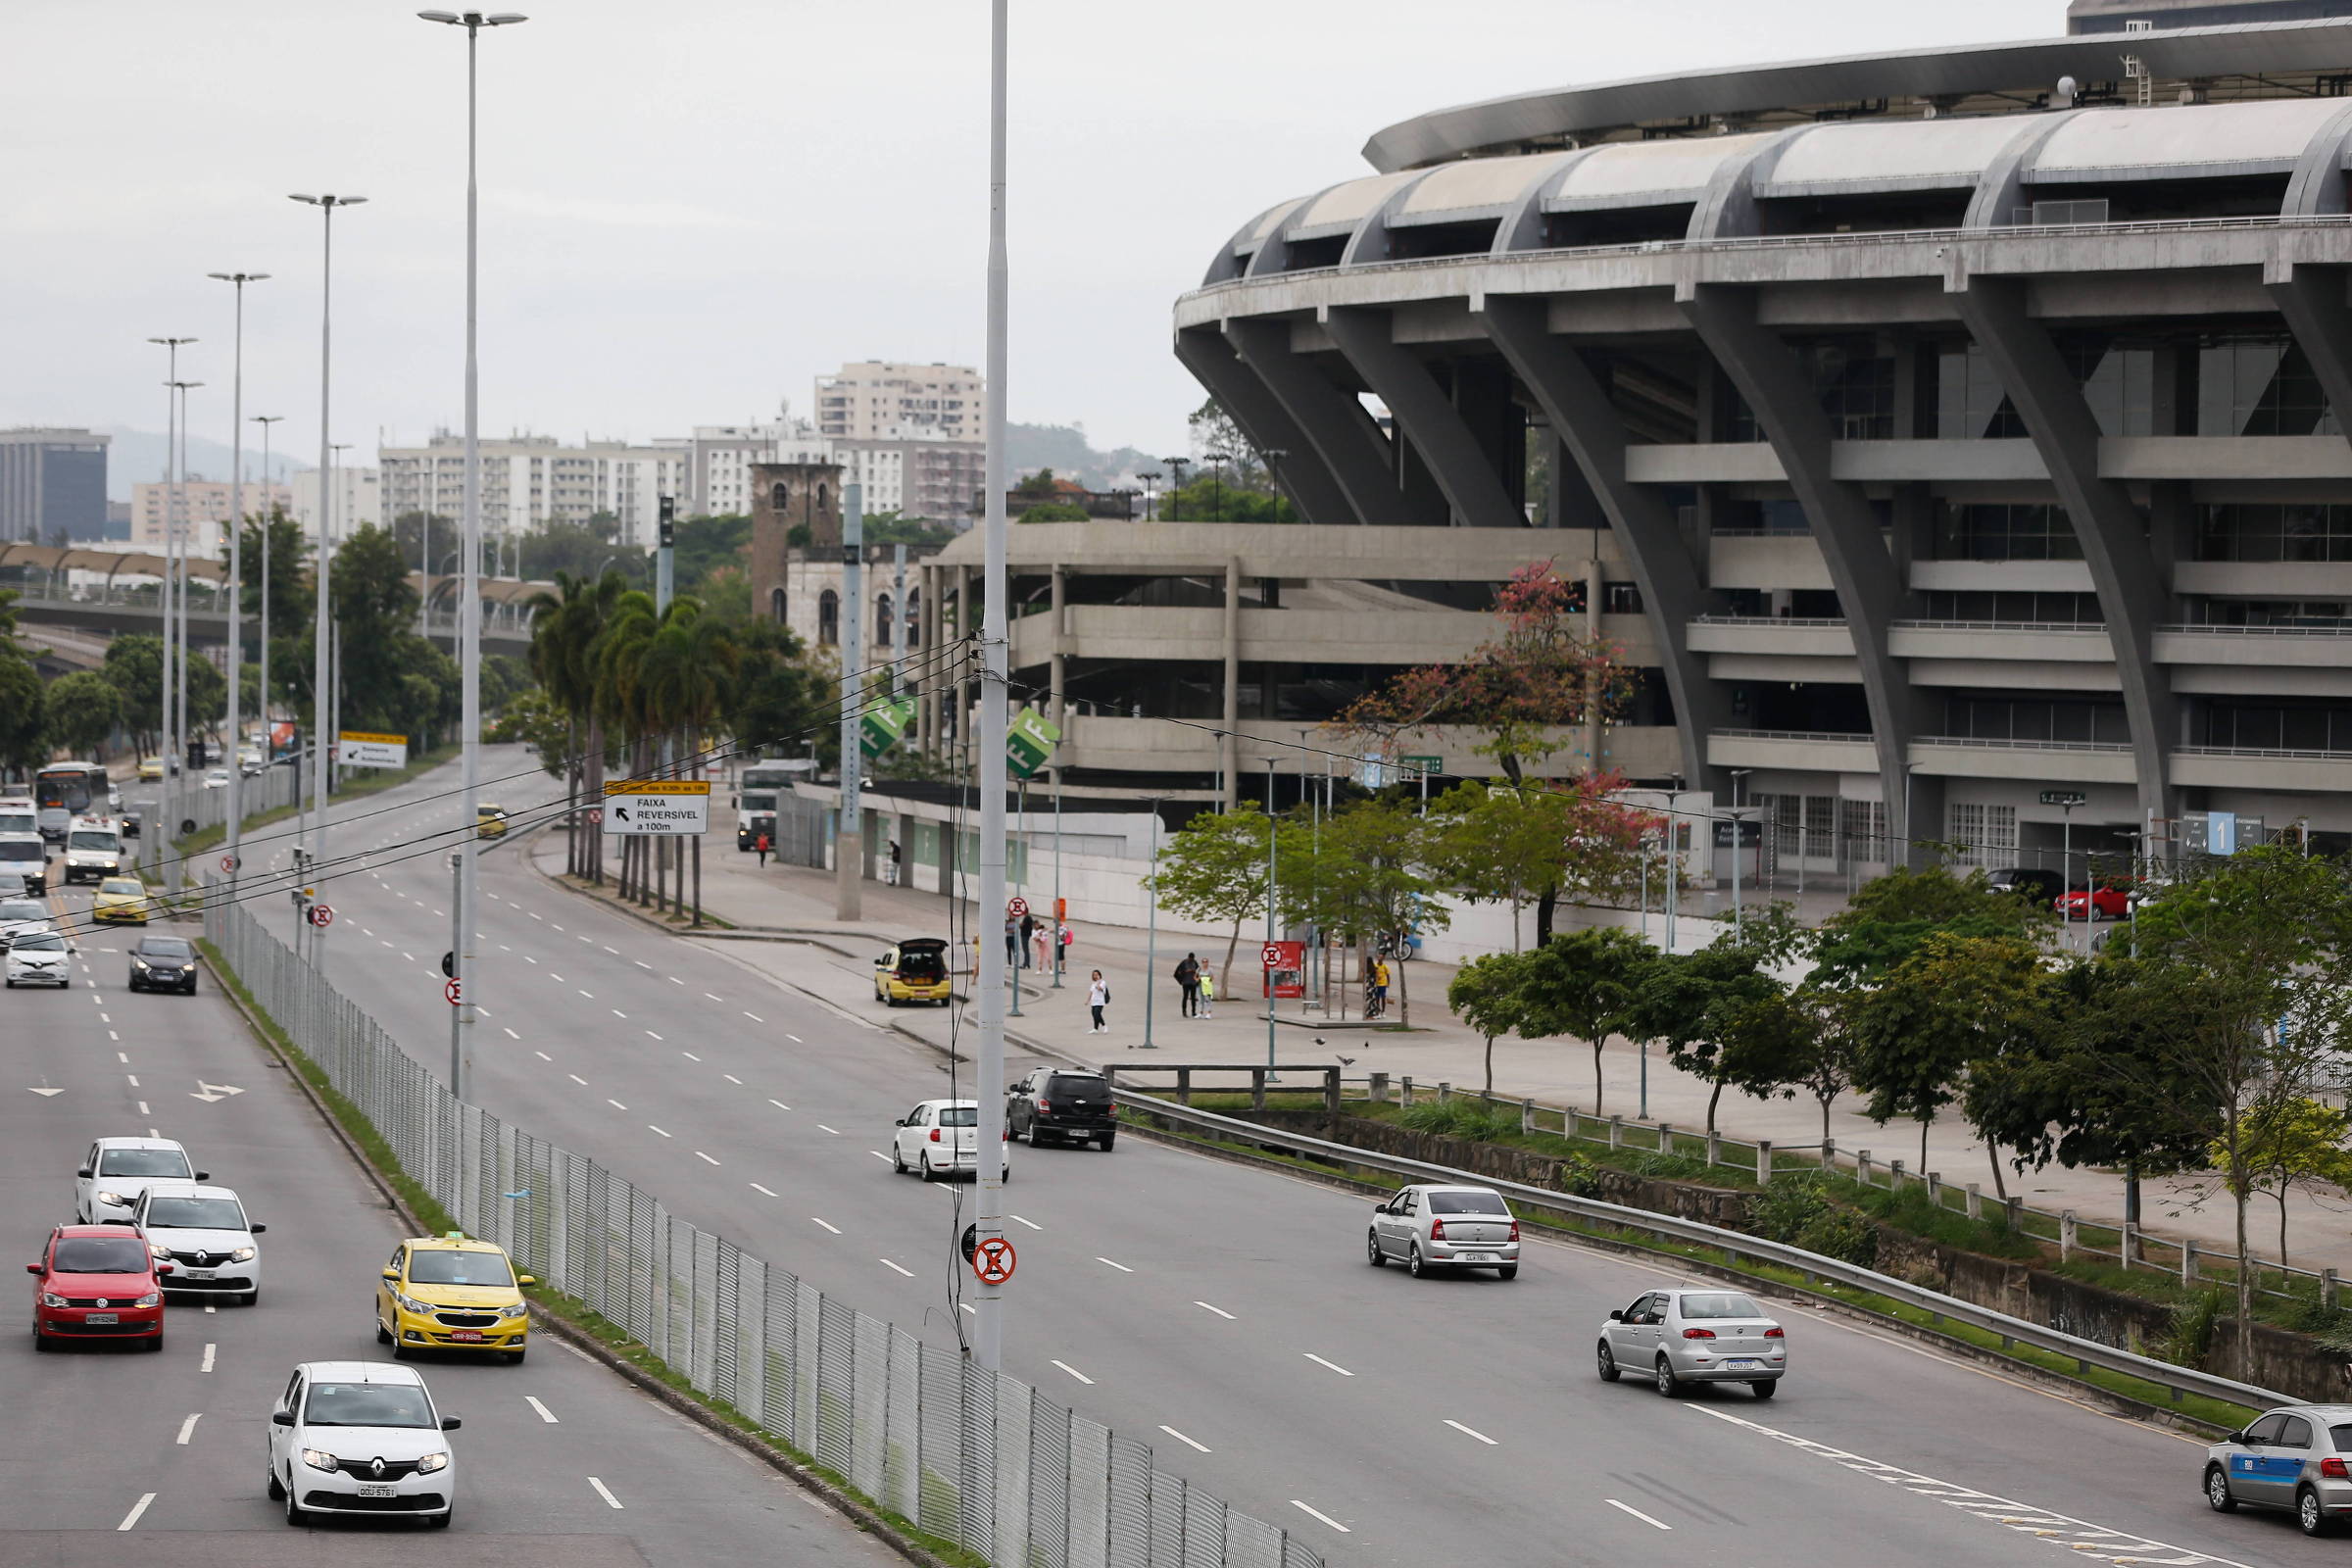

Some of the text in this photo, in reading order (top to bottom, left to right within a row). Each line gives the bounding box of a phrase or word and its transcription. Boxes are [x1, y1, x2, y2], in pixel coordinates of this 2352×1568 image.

[1024, 717, 1051, 745] F
[1006, 743, 1030, 769] F
[637, 799, 666, 808] FAIXA
[637, 808, 699, 820] REVERSÍVEL
[2218, 821, 2227, 850] 1
